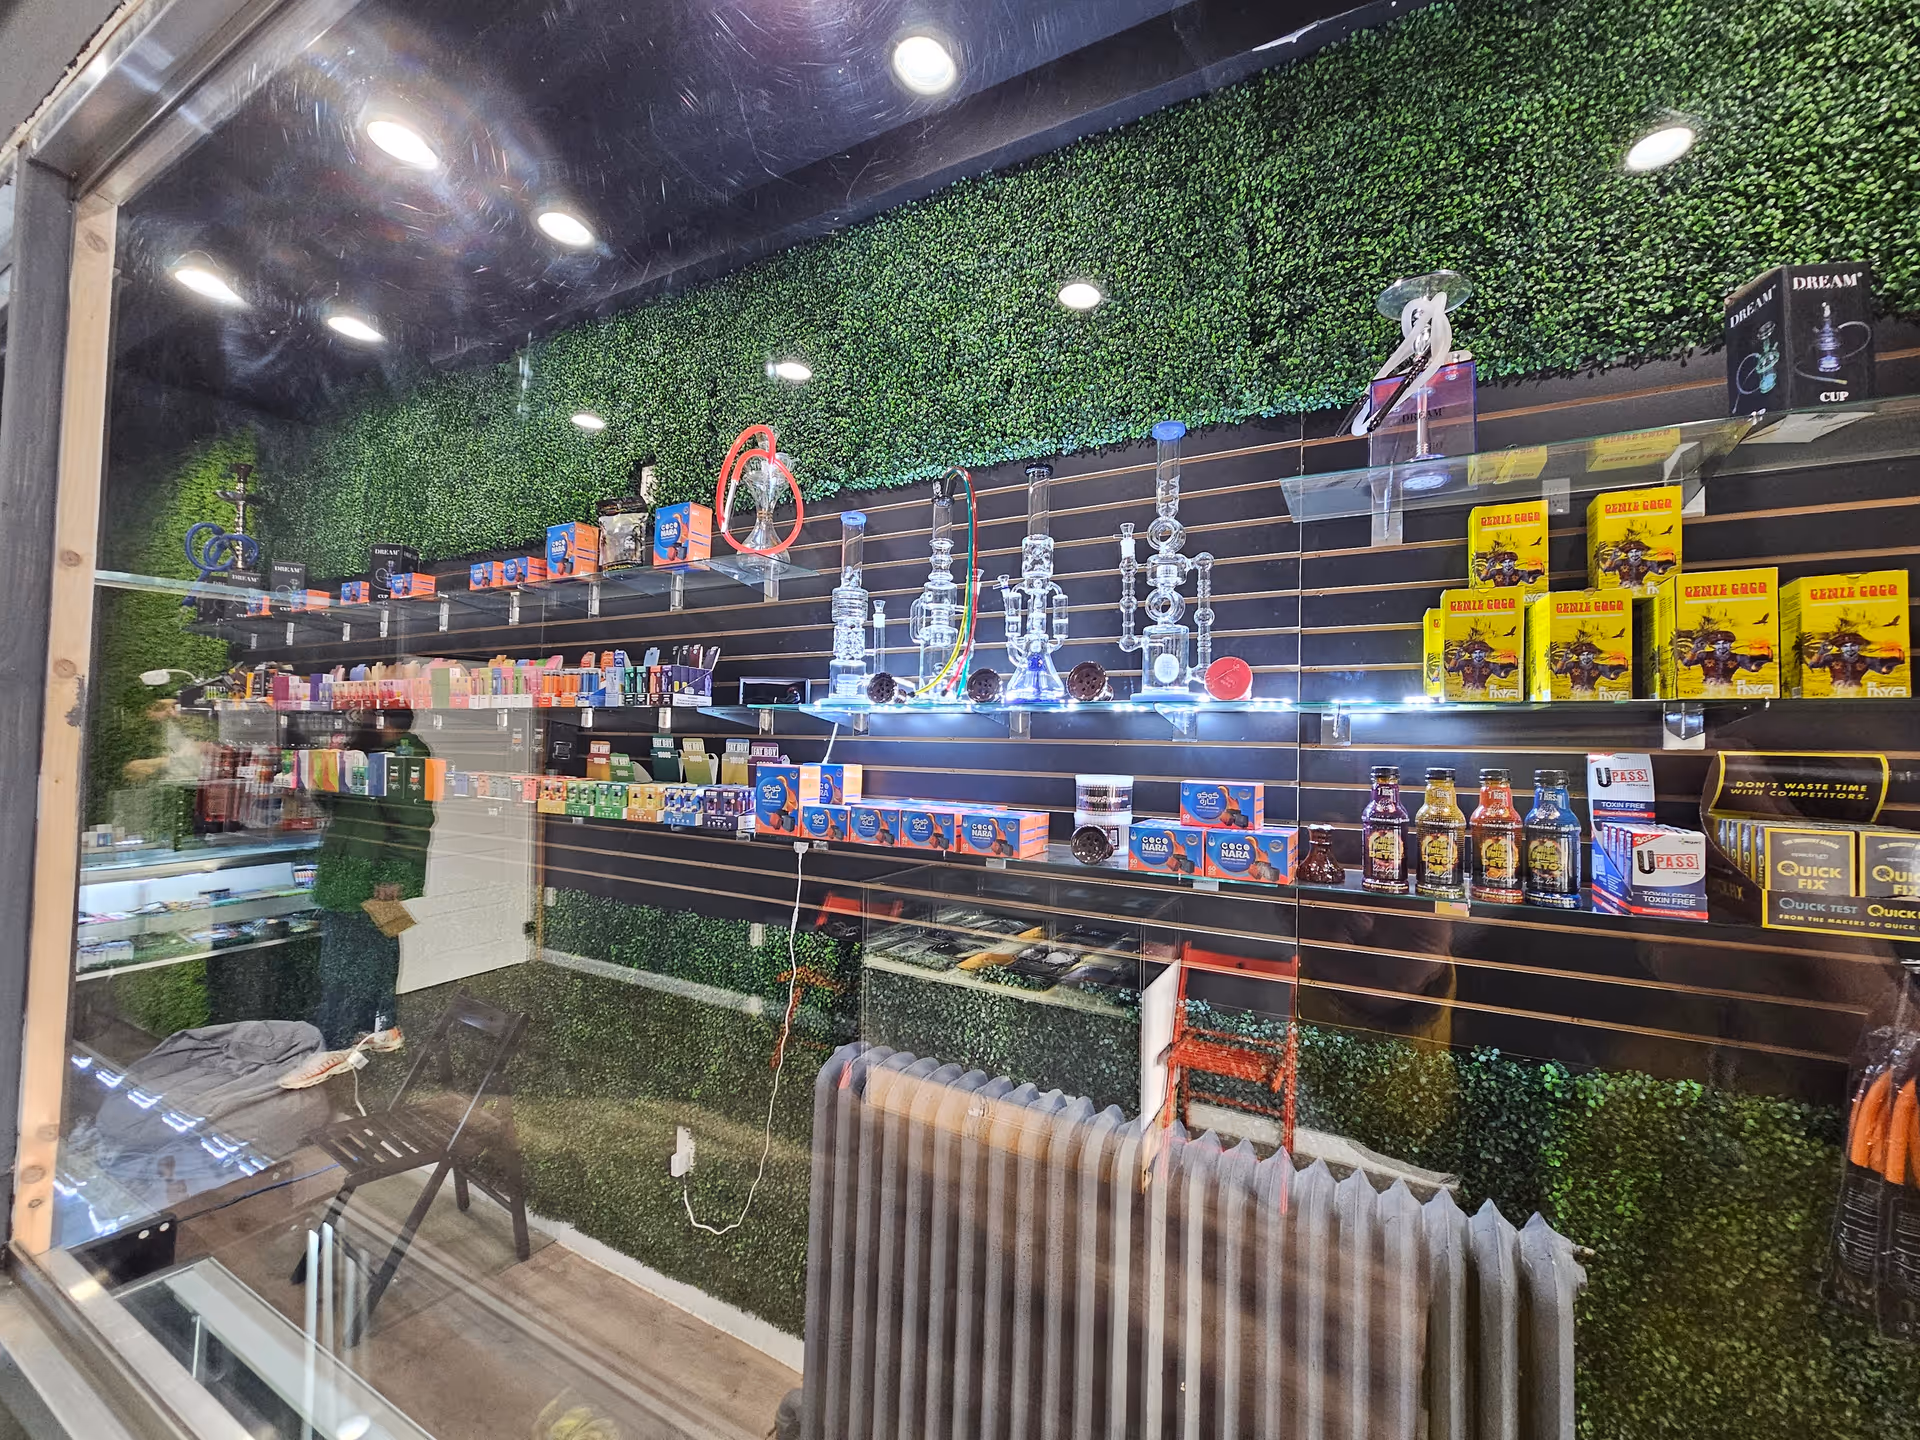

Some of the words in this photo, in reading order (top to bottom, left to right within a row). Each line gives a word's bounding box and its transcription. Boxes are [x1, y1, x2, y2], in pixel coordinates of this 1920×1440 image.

[1792, 274, 1858, 290] DREAM
[1730, 288, 1774, 328] DREAM
[1819, 391, 1849, 402] CUP
[753, 747, 763, 756] FAT
[765, 747, 777, 756] BOY
[1736, 781, 1779, 789] DON'T
[1835, 784, 1868, 792] TIME
[1730, 788, 1763, 796] WITH
[1769, 790, 1870, 800] COMPETITORS.
[972, 830, 992, 838] NARA
[1142, 836, 1168, 844] COCO
[1142, 843, 1168, 852] NARA
[1221, 842, 1250, 851] COCO
[1221, 850, 1250, 859] NARA
[1776, 860, 1842, 878] QUICK
[1798, 878, 1826, 890] FIX
[1643, 896, 1670, 904] TOXIN
[1779, 897, 1826, 911] QUICK
[1830, 904, 1858, 914] TEST
[1867, 904, 1916, 919] QUICK
[1828, 918, 1865, 927] MAKERS
[1884, 923, 1916, 931] QUICK
